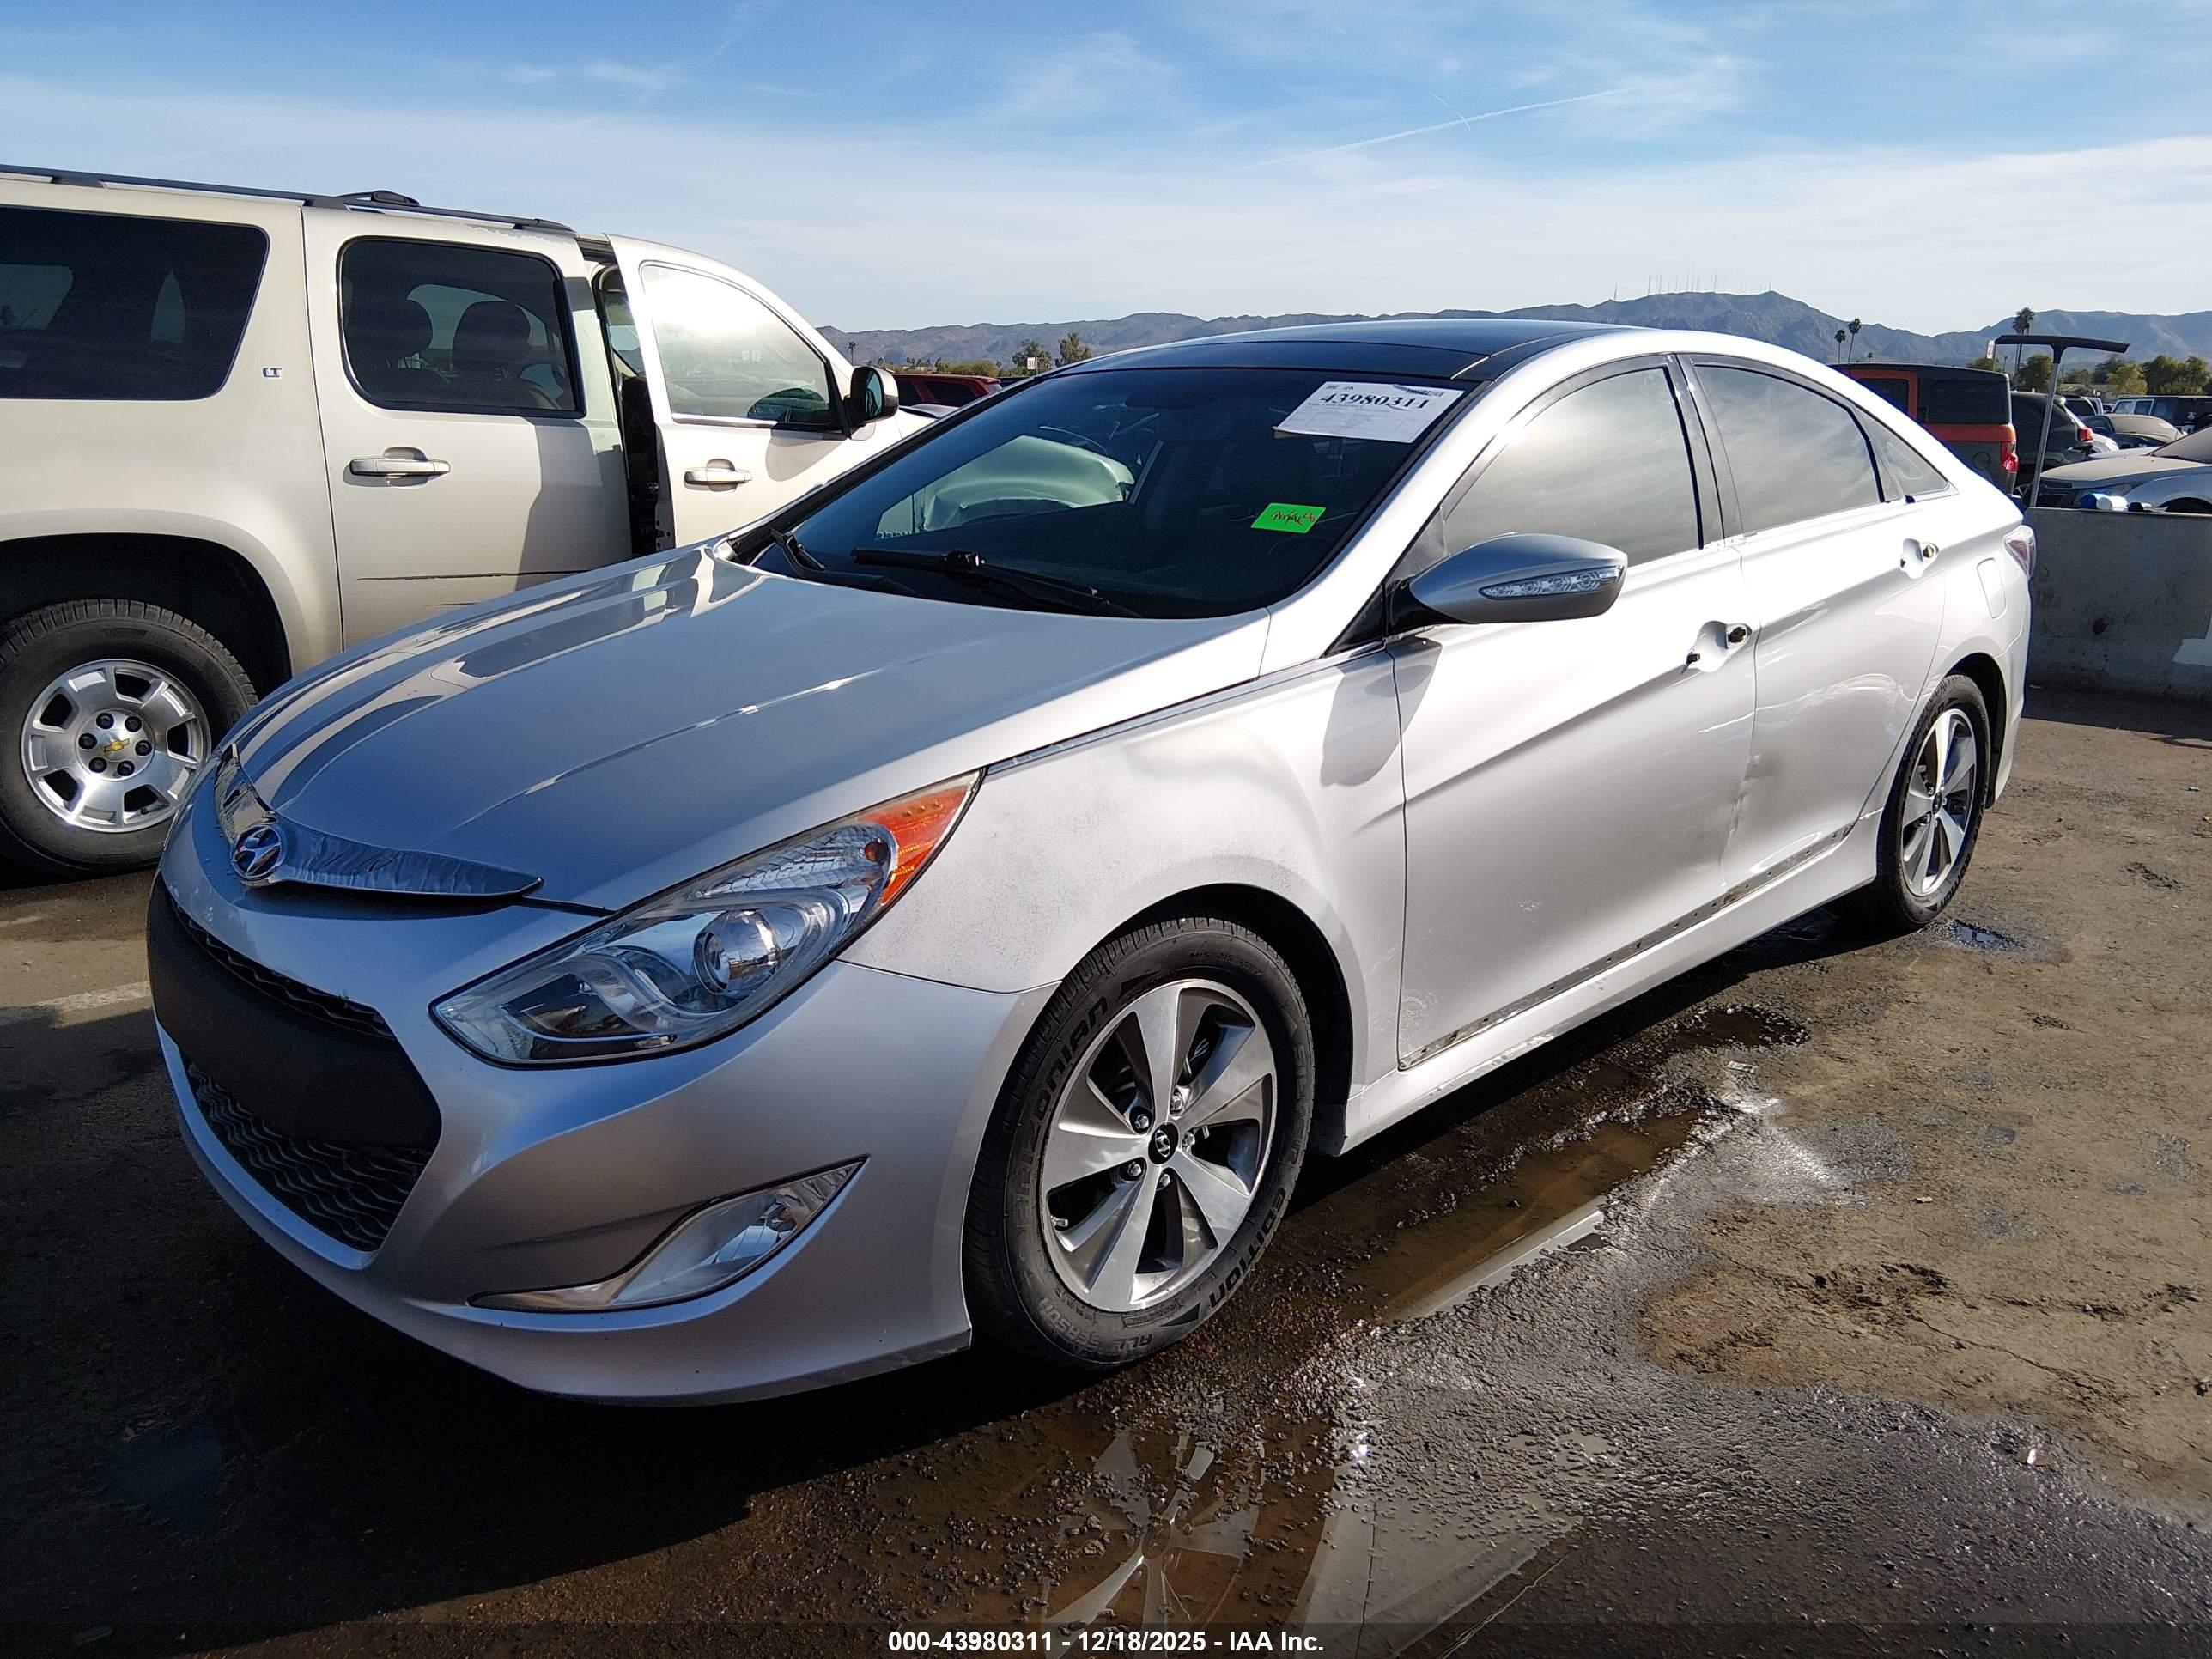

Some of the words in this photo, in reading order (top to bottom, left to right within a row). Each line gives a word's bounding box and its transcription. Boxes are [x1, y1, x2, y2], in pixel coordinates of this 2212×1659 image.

[262, 367, 283, 378] LT
[1320, 392, 1430, 409] 43980311
[1208, 1188, 1286, 1308] EDITION
[1039, 1297, 1106, 1353] SEASON
[1116, 1332, 1153, 1350] ALL
